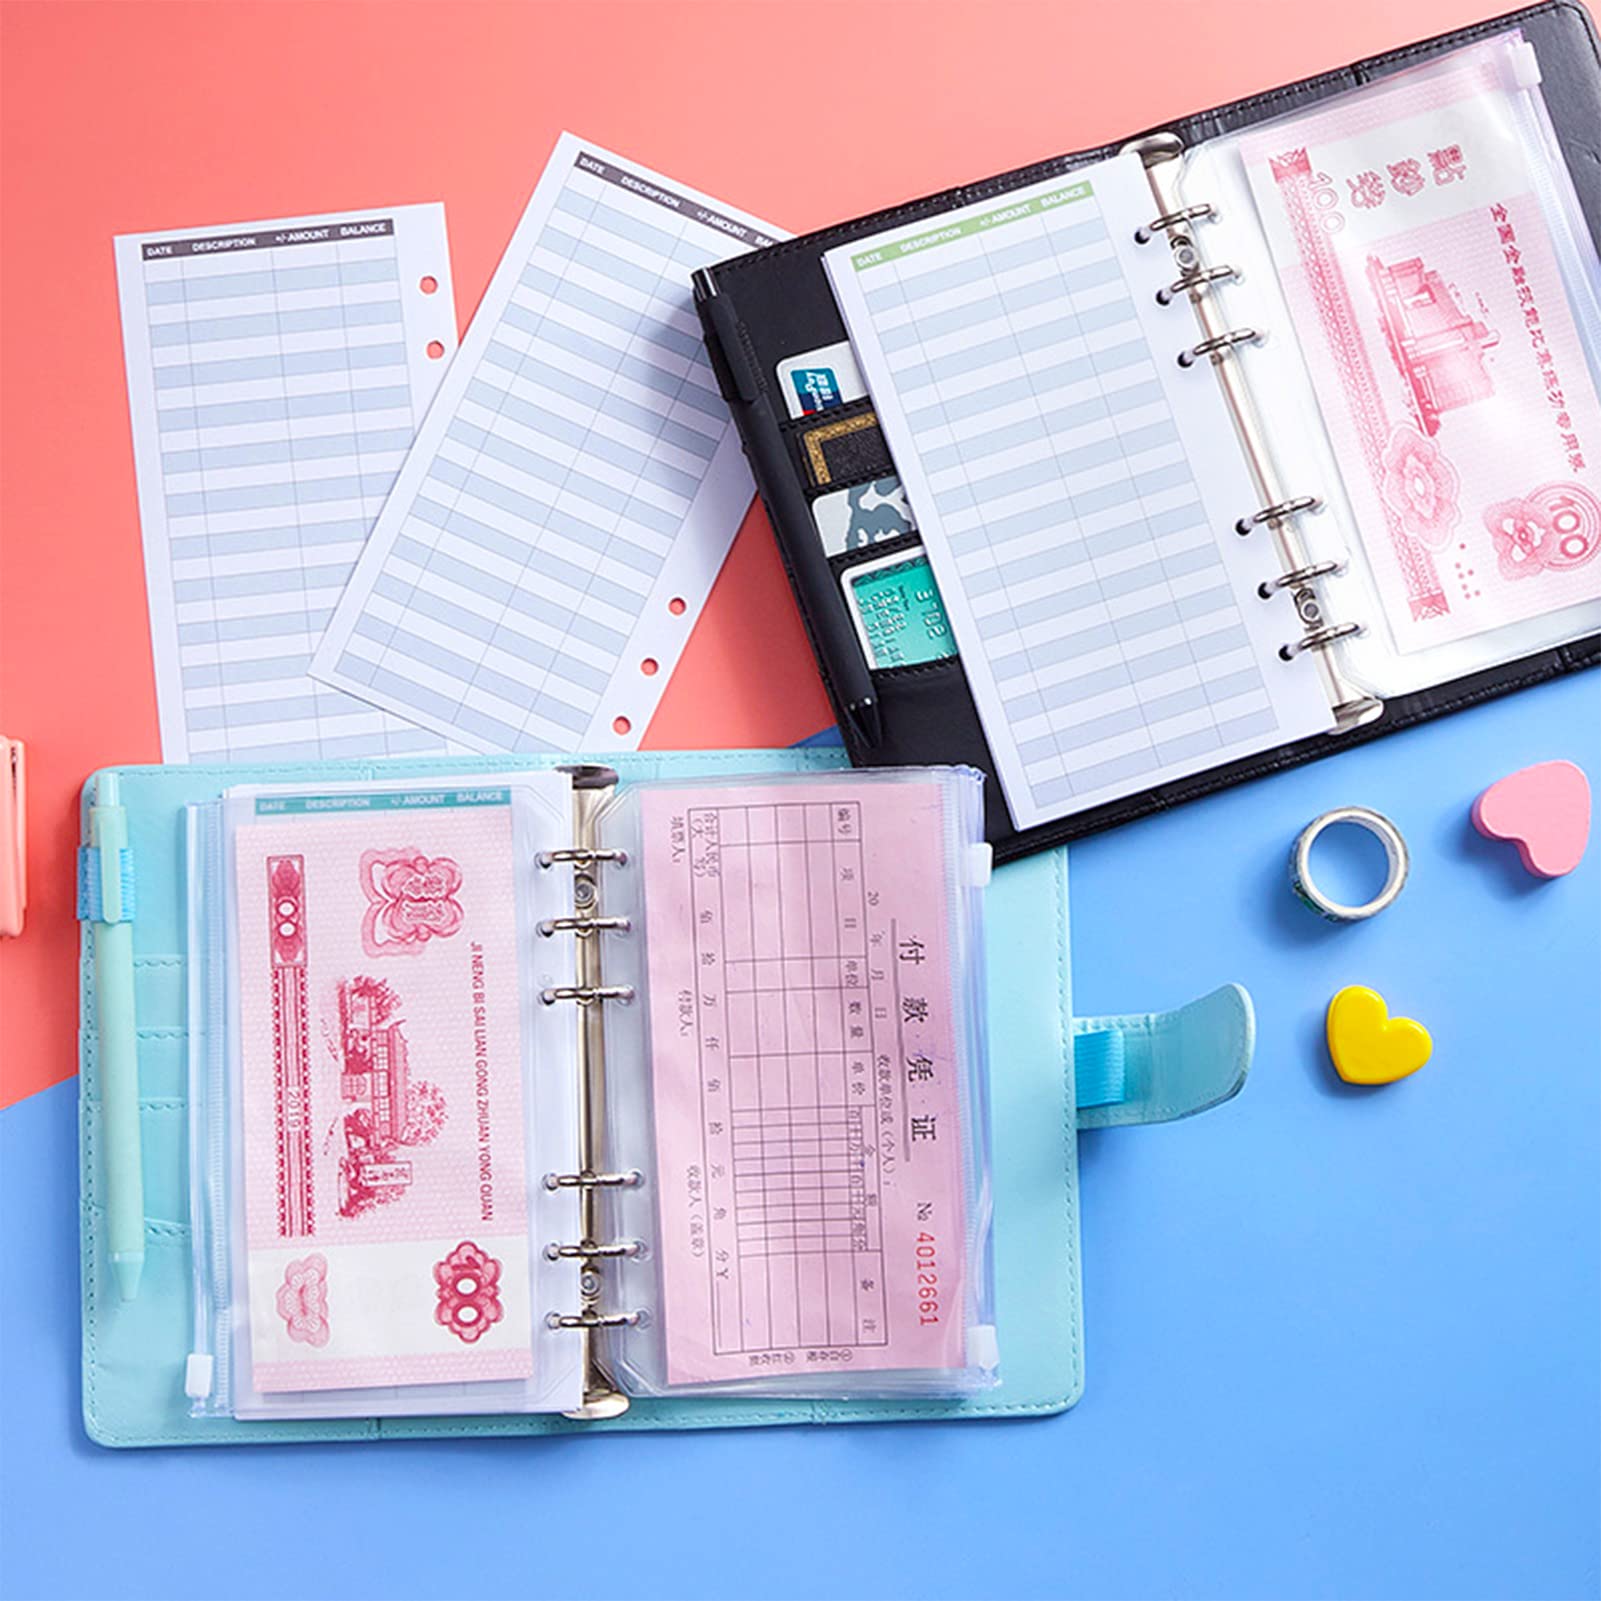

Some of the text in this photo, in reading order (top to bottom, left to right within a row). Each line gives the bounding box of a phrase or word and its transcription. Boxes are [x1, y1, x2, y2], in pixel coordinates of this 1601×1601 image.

[579, 157, 604, 174] DATE
[621, 176, 680, 208] DESCRIPTION
[146, 245, 173, 257] DATE
[192, 238, 255, 252] DESCRIPTION
[340, 222, 387, 237] BALANCE
[856, 252, 883, 267] DATE
[900, 227, 962, 253] DESCRIPTION
[1040, 186, 1086, 208] BALANCE
[260, 800, 286, 811] DATE
[306, 797, 371, 810] DESCRIPTION
[457, 790, 504, 802] BALANCE
[837, 807, 853, 835] 编号
[867, 891, 880, 906] 20
[471, 942, 494, 1222] JI NENG BI SAI LIAN GONG ZHUAN YONG QUAN
[287, 1090, 301, 1129] 2019
[451, 1254, 482, 1328] 100
[916, 1232, 938, 1327] 4012661
